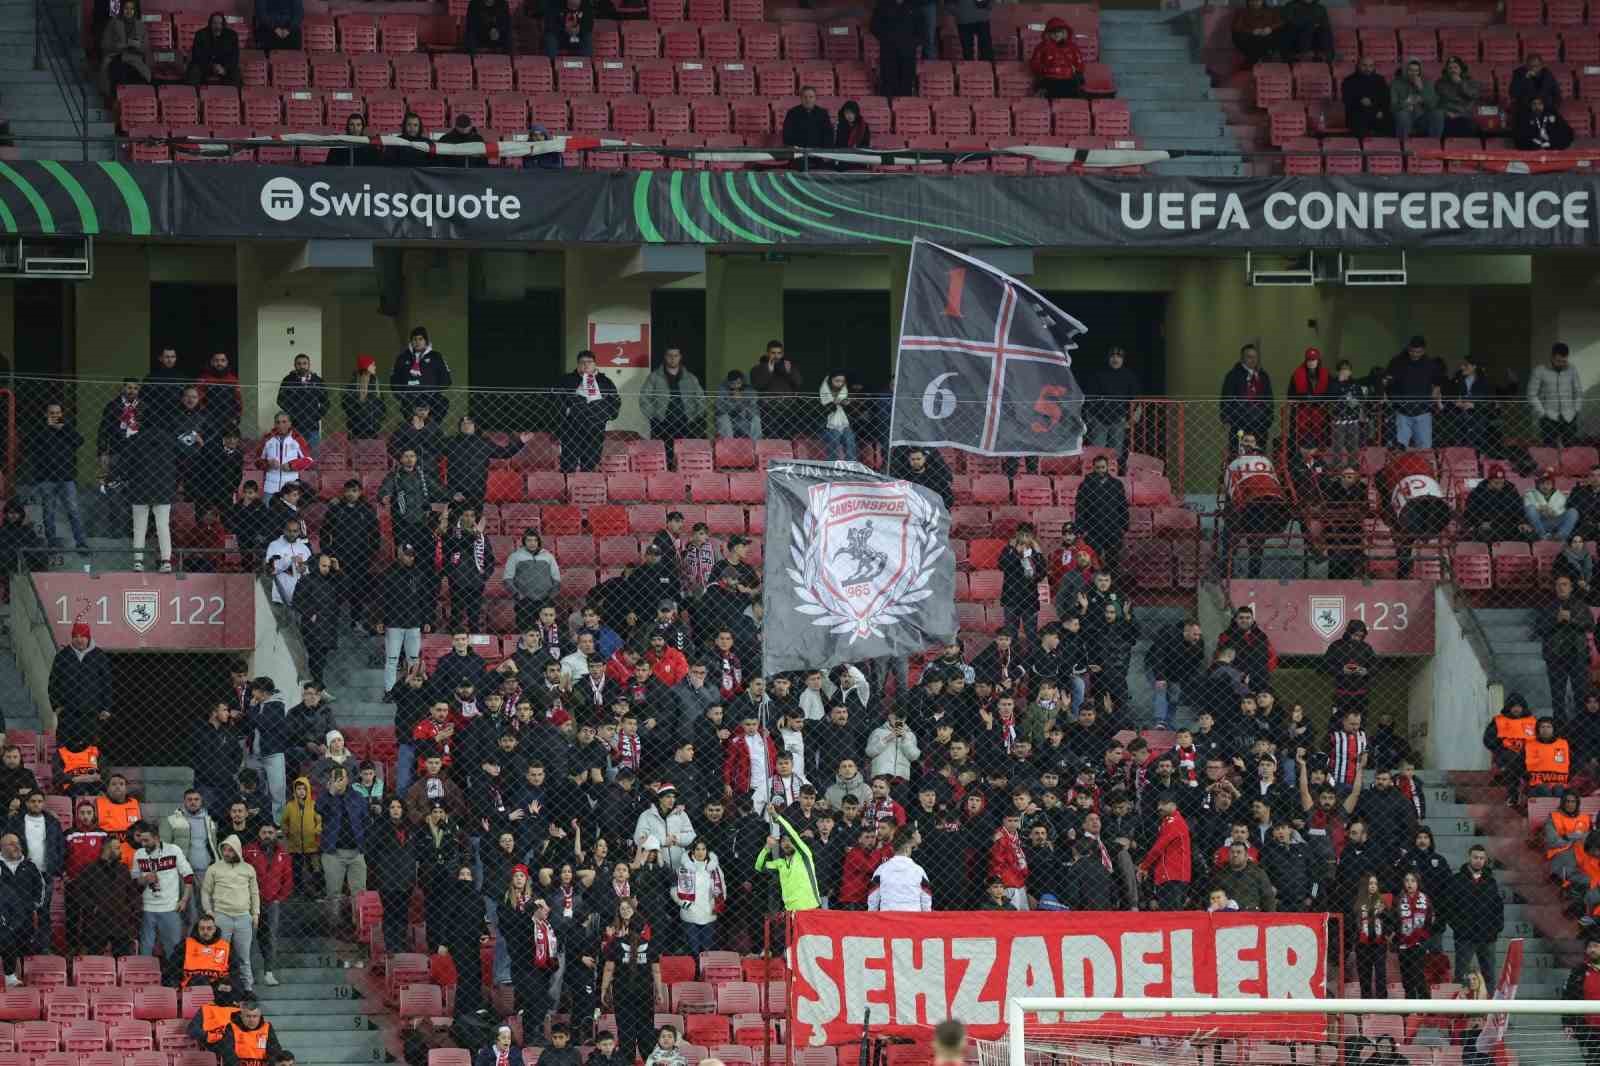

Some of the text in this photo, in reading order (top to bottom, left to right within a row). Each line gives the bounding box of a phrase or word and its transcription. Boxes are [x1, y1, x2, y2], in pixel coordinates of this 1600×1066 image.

[309, 181, 521, 227] Swissquote
[1120, 191, 1590, 230] UEFA CONFERENCE
[941, 266, 967, 320] 1
[922, 372, 1069, 433] 6 5
[829, 500, 905, 518] SAMSUNSPOR
[168, 596, 225, 625] 122
[1353, 602, 1408, 631] 123
[1435, 791, 1448, 801] 16
[1456, 821, 1470, 833] 15
[334, 986, 348, 998] 10
[796, 924, 1318, 1046] ŞEHZADELER
[353, 1016, 361, 1028] 9
